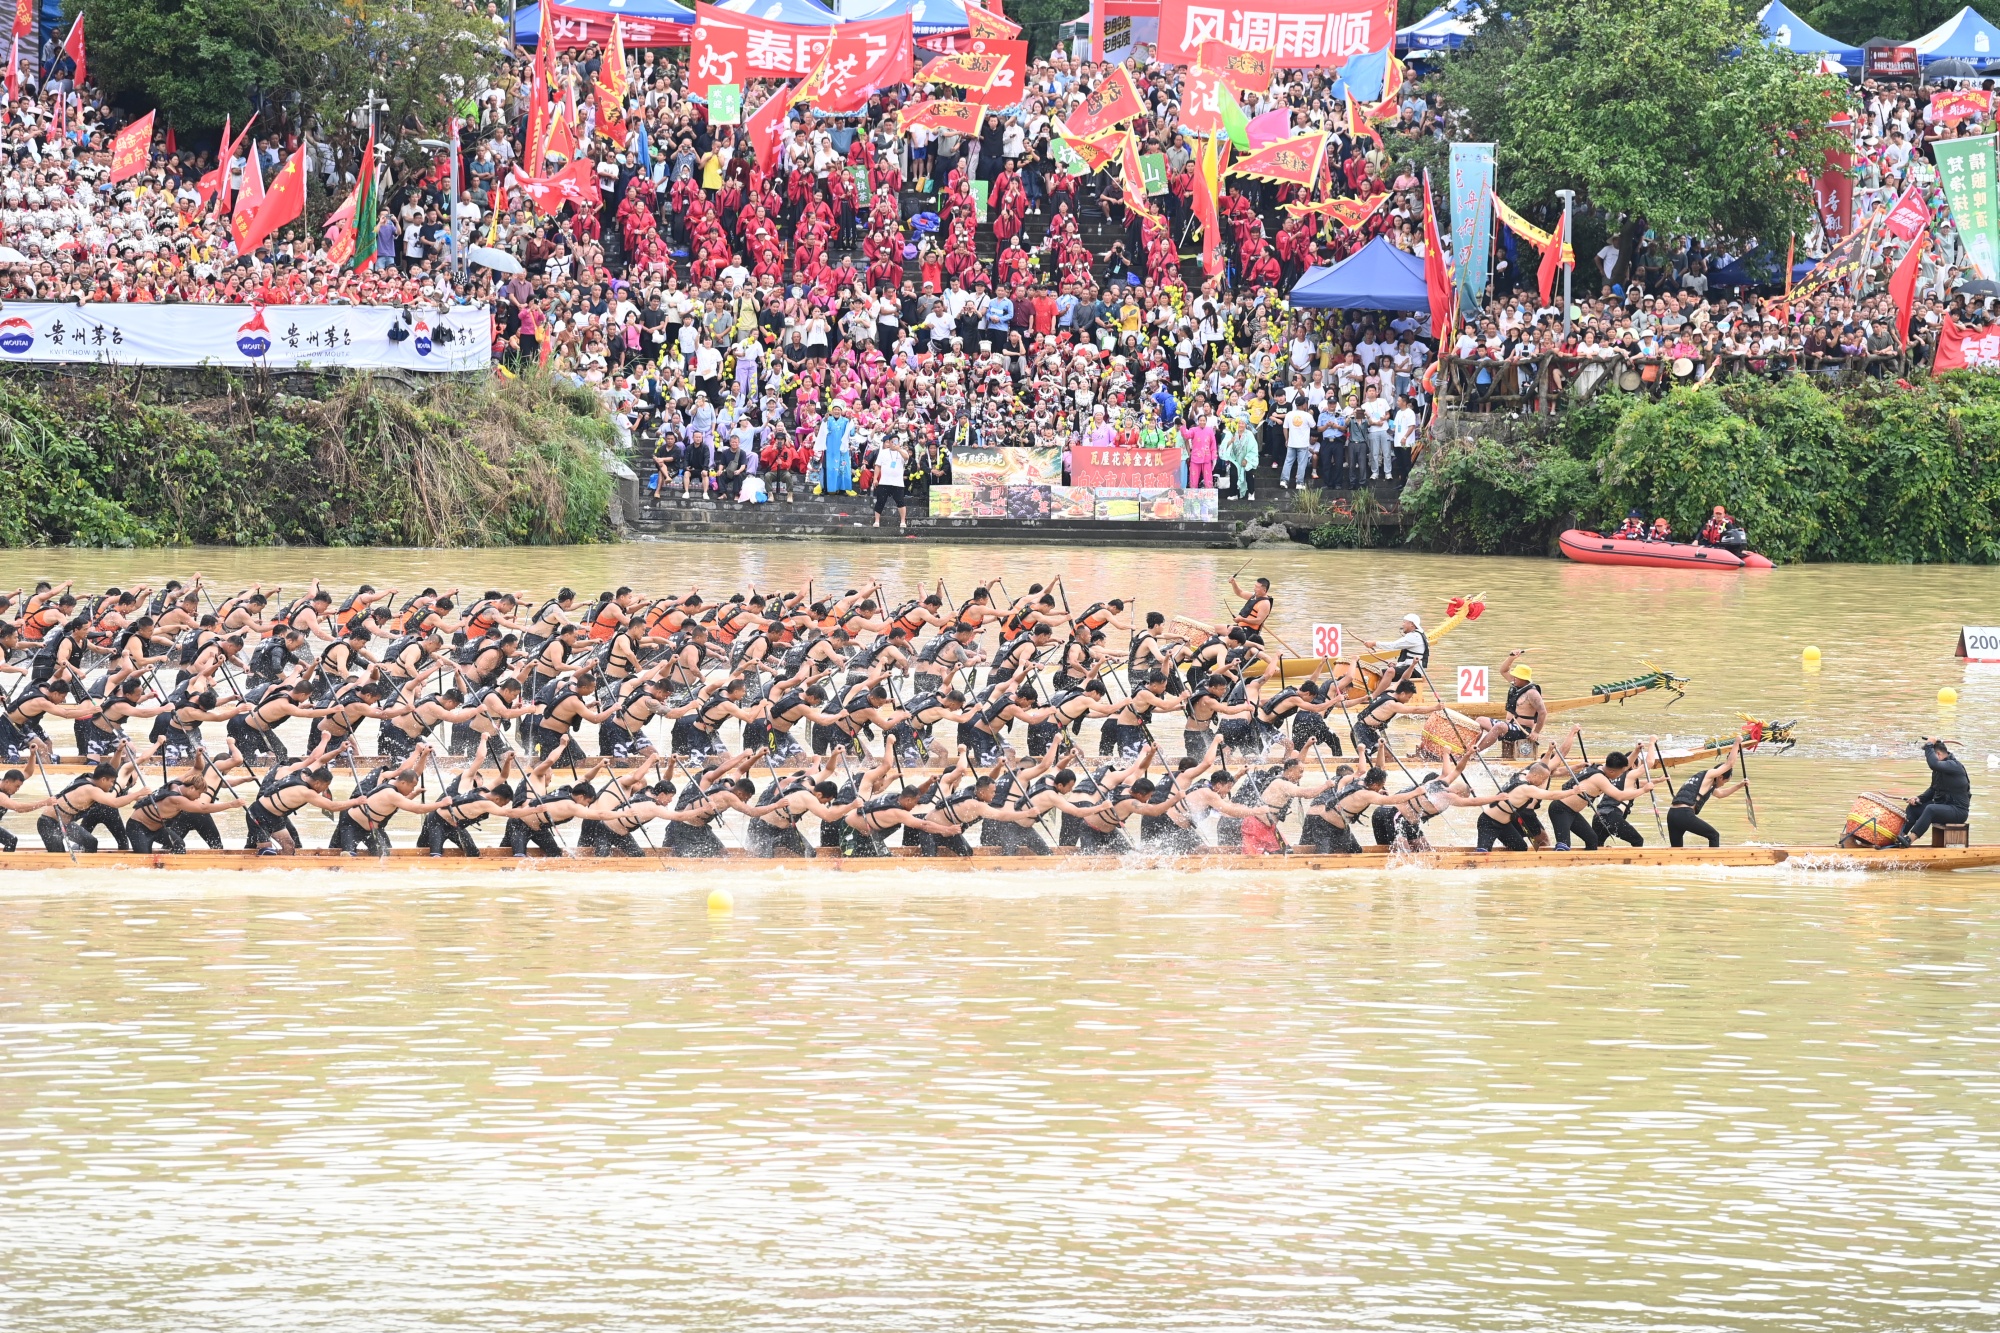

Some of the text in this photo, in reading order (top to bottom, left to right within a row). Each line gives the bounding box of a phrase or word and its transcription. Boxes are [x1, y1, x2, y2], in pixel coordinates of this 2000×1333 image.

[1104, 16, 1131, 35] 电解质
[1180, 5, 1373, 58] 风调雨顺
[1103, 30, 1131, 53] 电解质
[698, 44, 738, 84] 灯
[818, 53, 858, 98] 塔
[713, 89, 722, 109] 欢迎
[725, 94, 734, 115] 来到
[1190, 81, 1222, 116] 油
[856, 170, 867, 202] 喝抹茶
[1144, 163, 1160, 183] 山
[45, 319, 124, 346] 贵州茅台
[281, 322, 351, 348] 贵州茅台
[957, 451, 1005, 467] 瓦屋花海金龙
[1090, 450, 1164, 467] 瓦屋花海金龙队
[1316, 626, 1339, 657] 38
[1969, 635, 2000, 650] 200
[1461, 669, 1486, 696] 24
